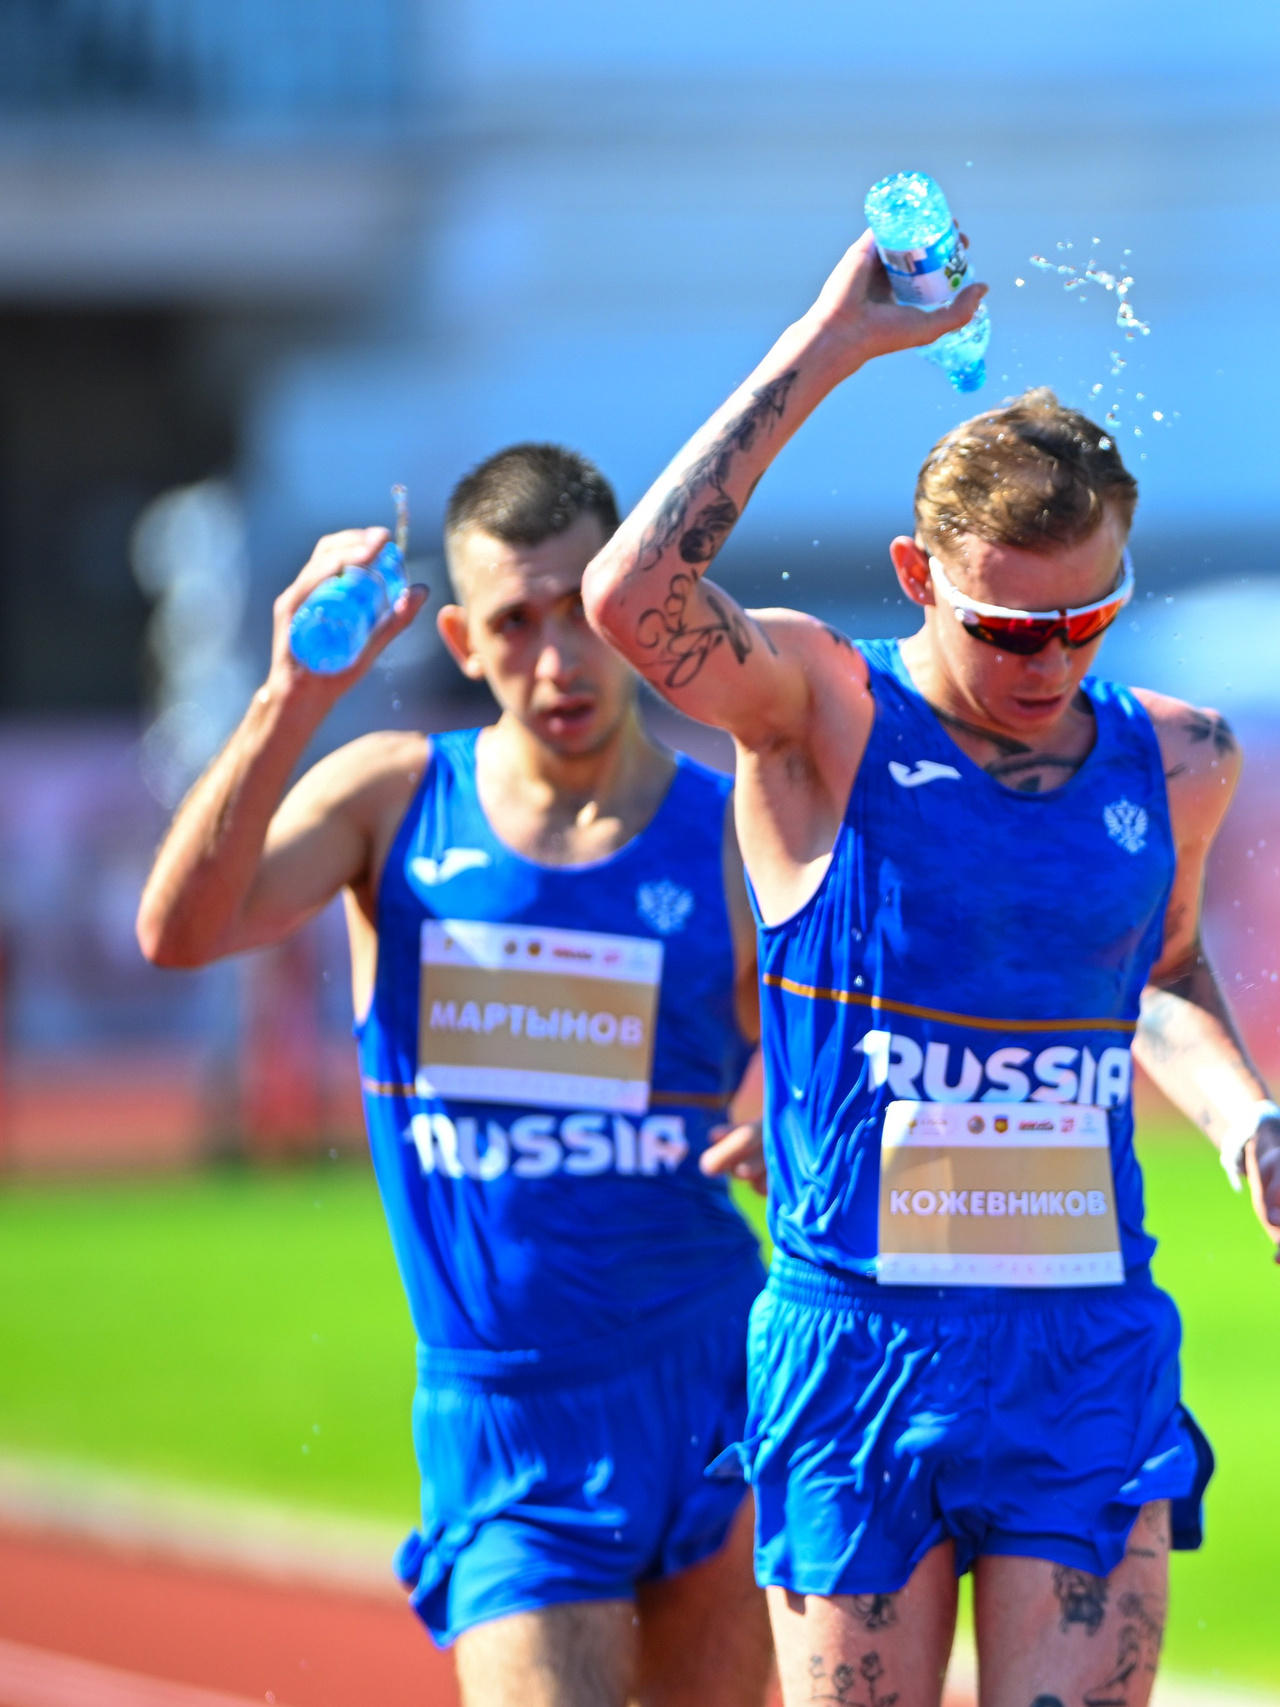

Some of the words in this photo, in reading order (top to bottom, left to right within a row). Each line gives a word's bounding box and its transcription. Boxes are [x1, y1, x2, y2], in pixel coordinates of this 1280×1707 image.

[430, 1001, 644, 1047] МАРТЫНОВ
[852, 1029, 1134, 1109] RUSSIA
[402, 1112, 689, 1181] RUSSIA
[890, 1189, 1108, 1216] КОЖЕВНИКОВ
